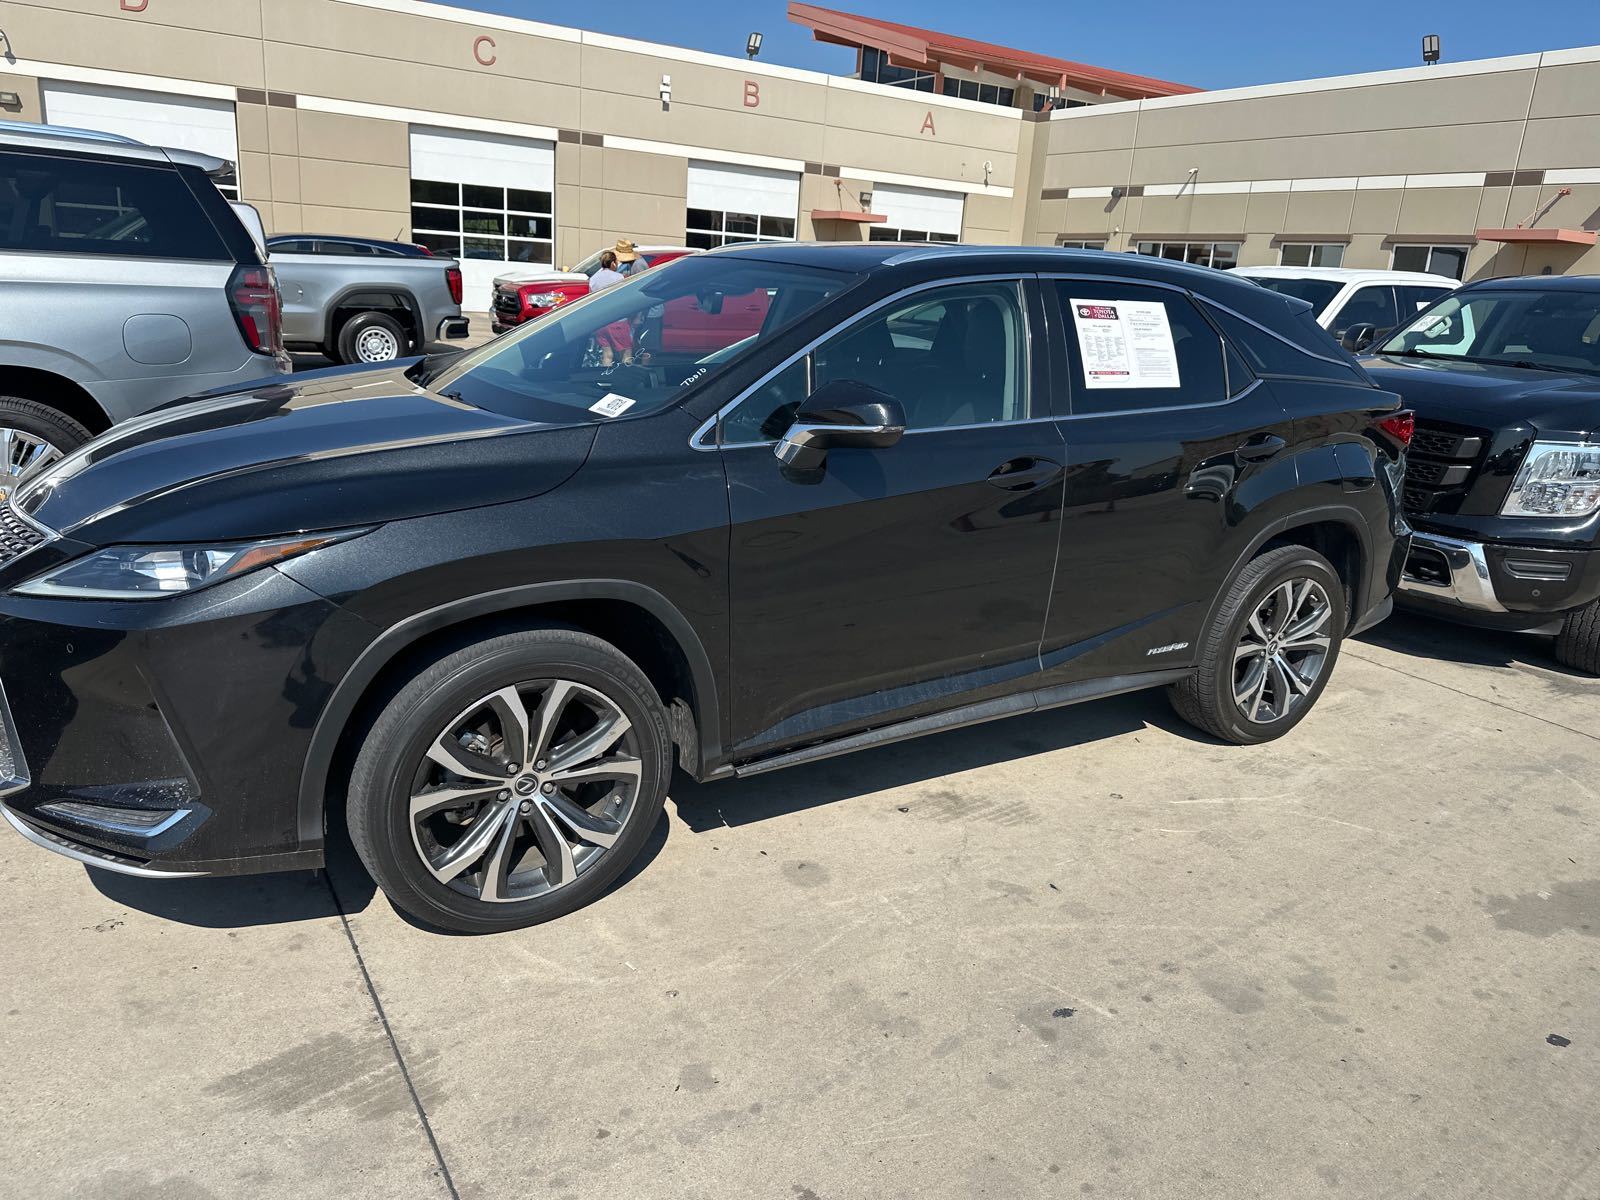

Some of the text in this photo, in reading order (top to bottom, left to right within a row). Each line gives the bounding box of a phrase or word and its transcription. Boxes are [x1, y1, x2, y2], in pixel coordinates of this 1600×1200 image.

[473, 36, 497, 65] C
[743, 80, 760, 107] B
[920, 111, 936, 136] A
